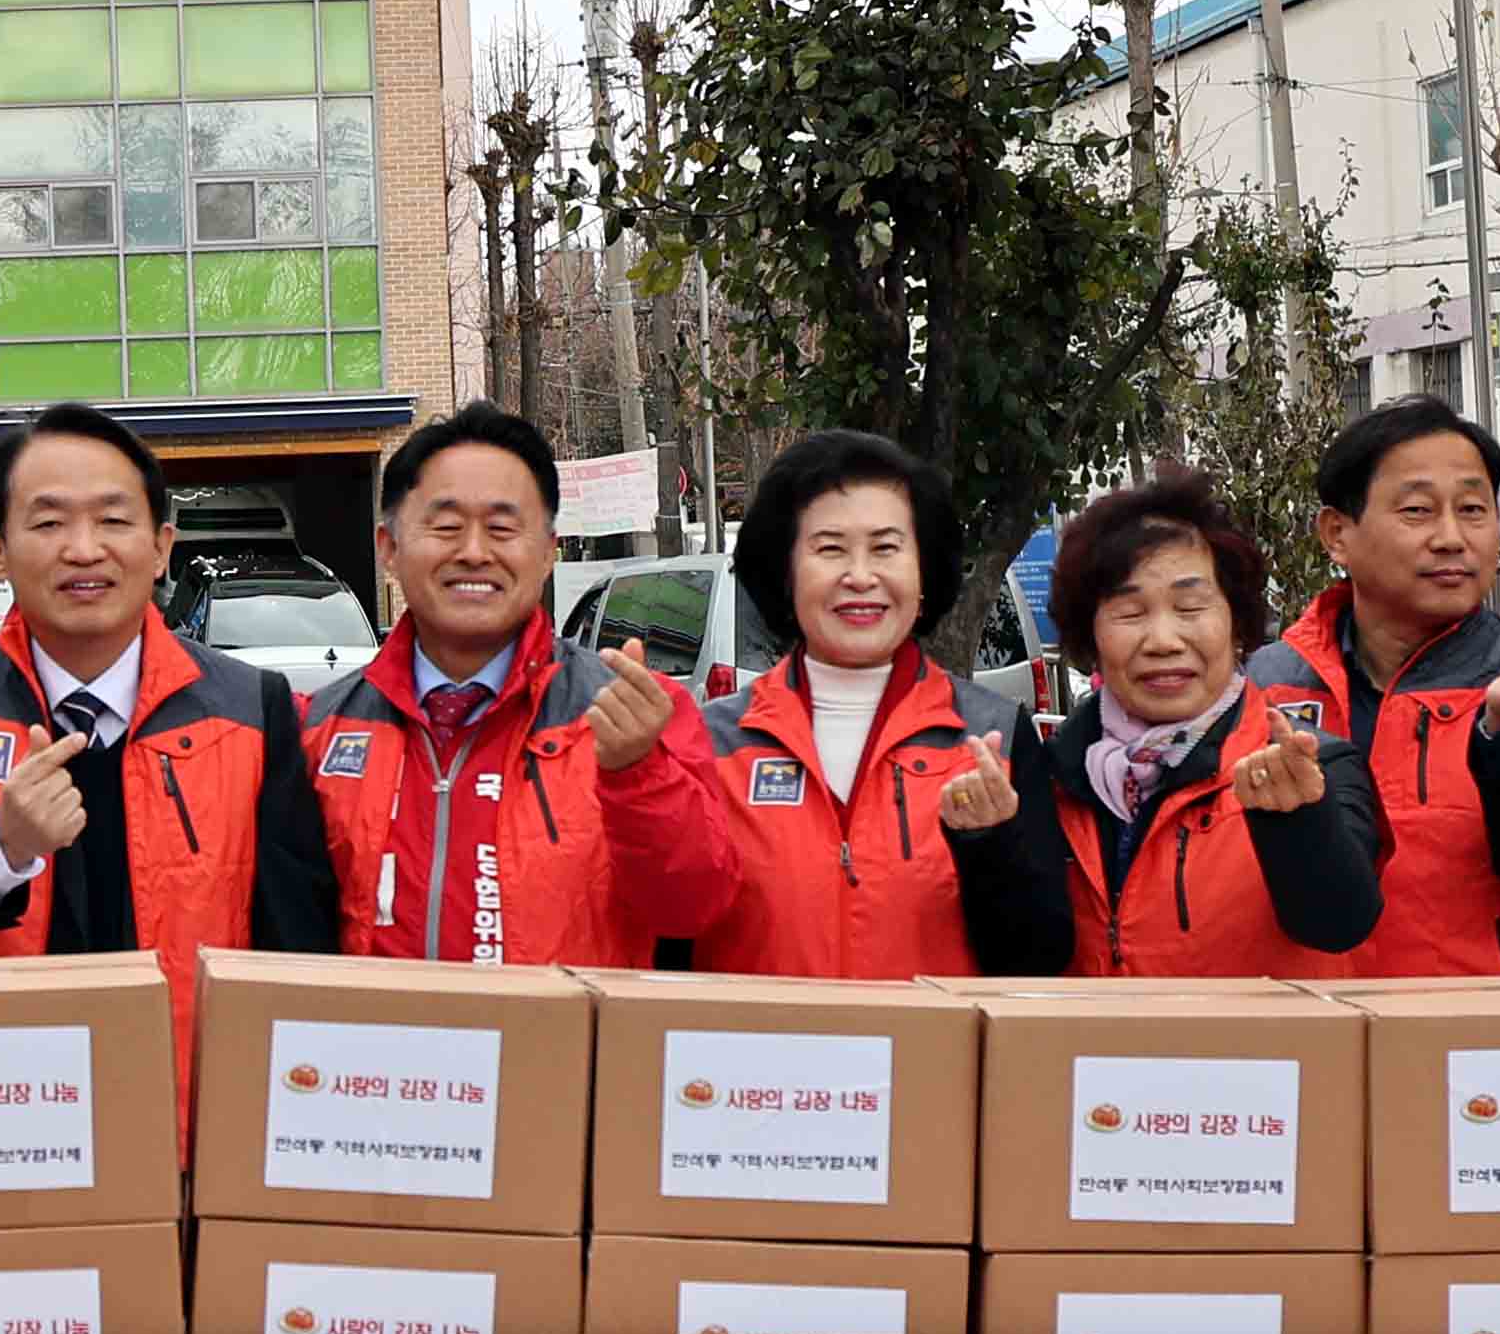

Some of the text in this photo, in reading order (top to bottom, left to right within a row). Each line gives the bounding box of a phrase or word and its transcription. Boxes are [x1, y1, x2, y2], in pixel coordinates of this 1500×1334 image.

[39, 1081, 80, 1105] 나눔
[724, 1087, 880, 1114] 사랑의 김장 나눔
